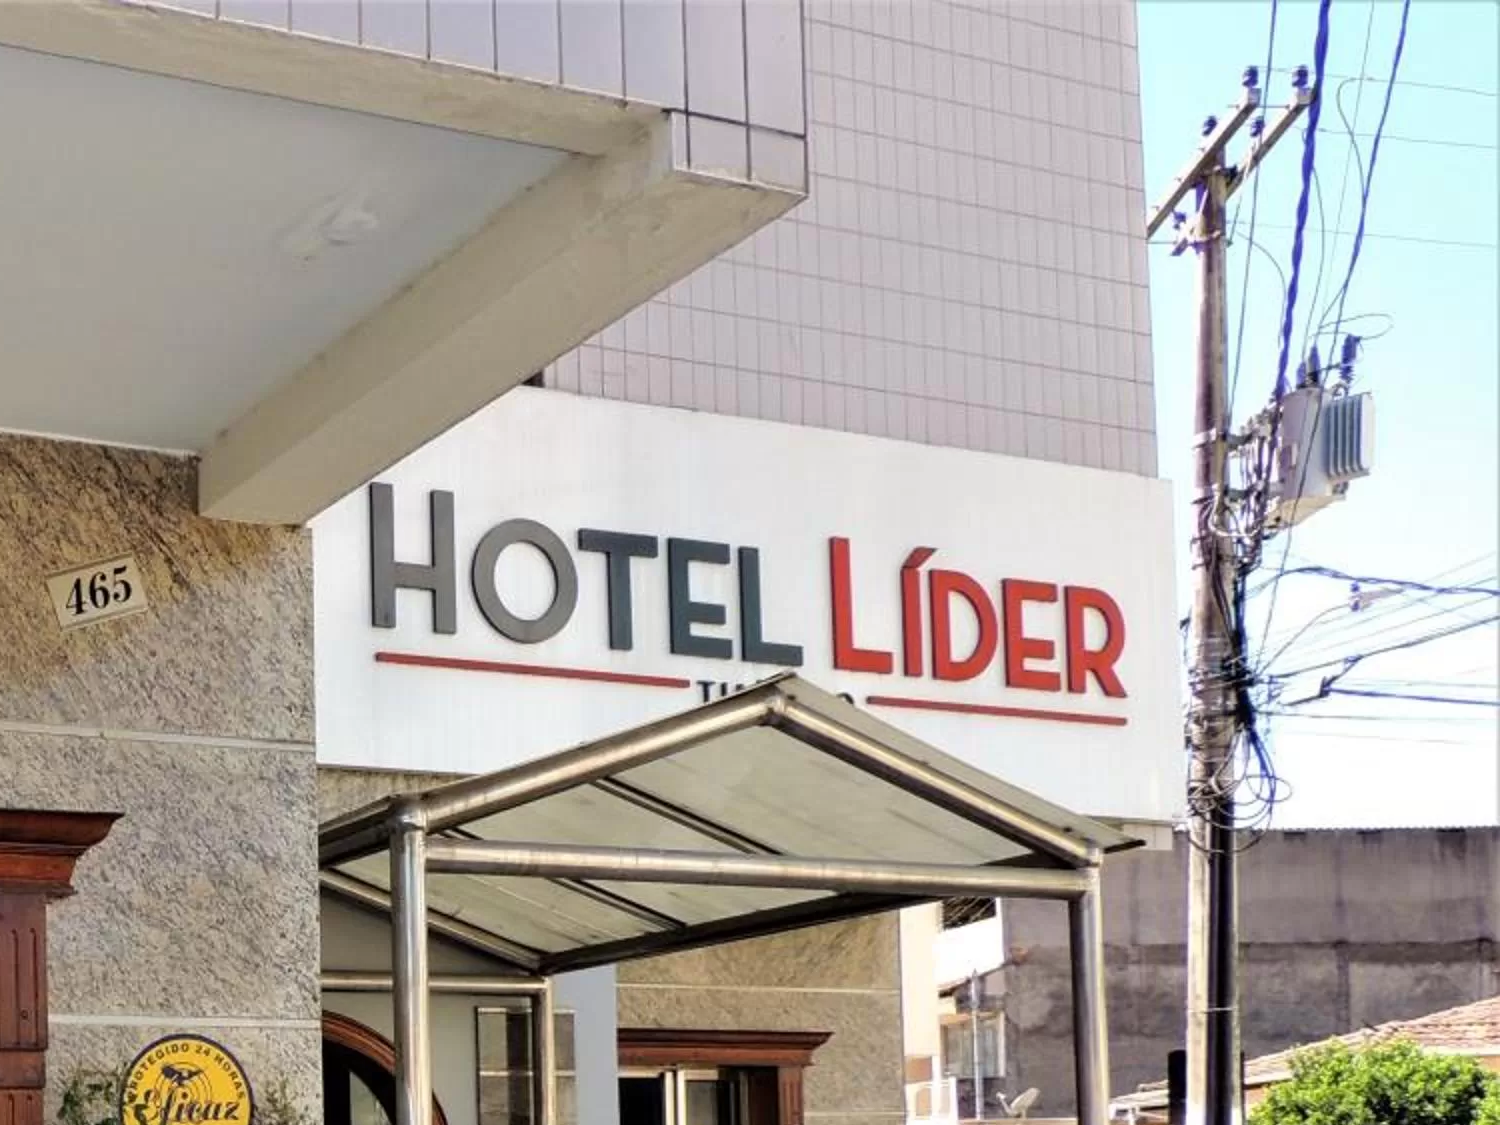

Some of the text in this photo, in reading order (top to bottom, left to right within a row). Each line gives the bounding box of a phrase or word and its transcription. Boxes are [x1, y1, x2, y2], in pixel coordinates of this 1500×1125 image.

[66, 565, 132, 615] 465
[368, 481, 1127, 699] HOTEL LÍDER
[126, 1042, 246, 1104] PROTEGIDO 24 HORAS
